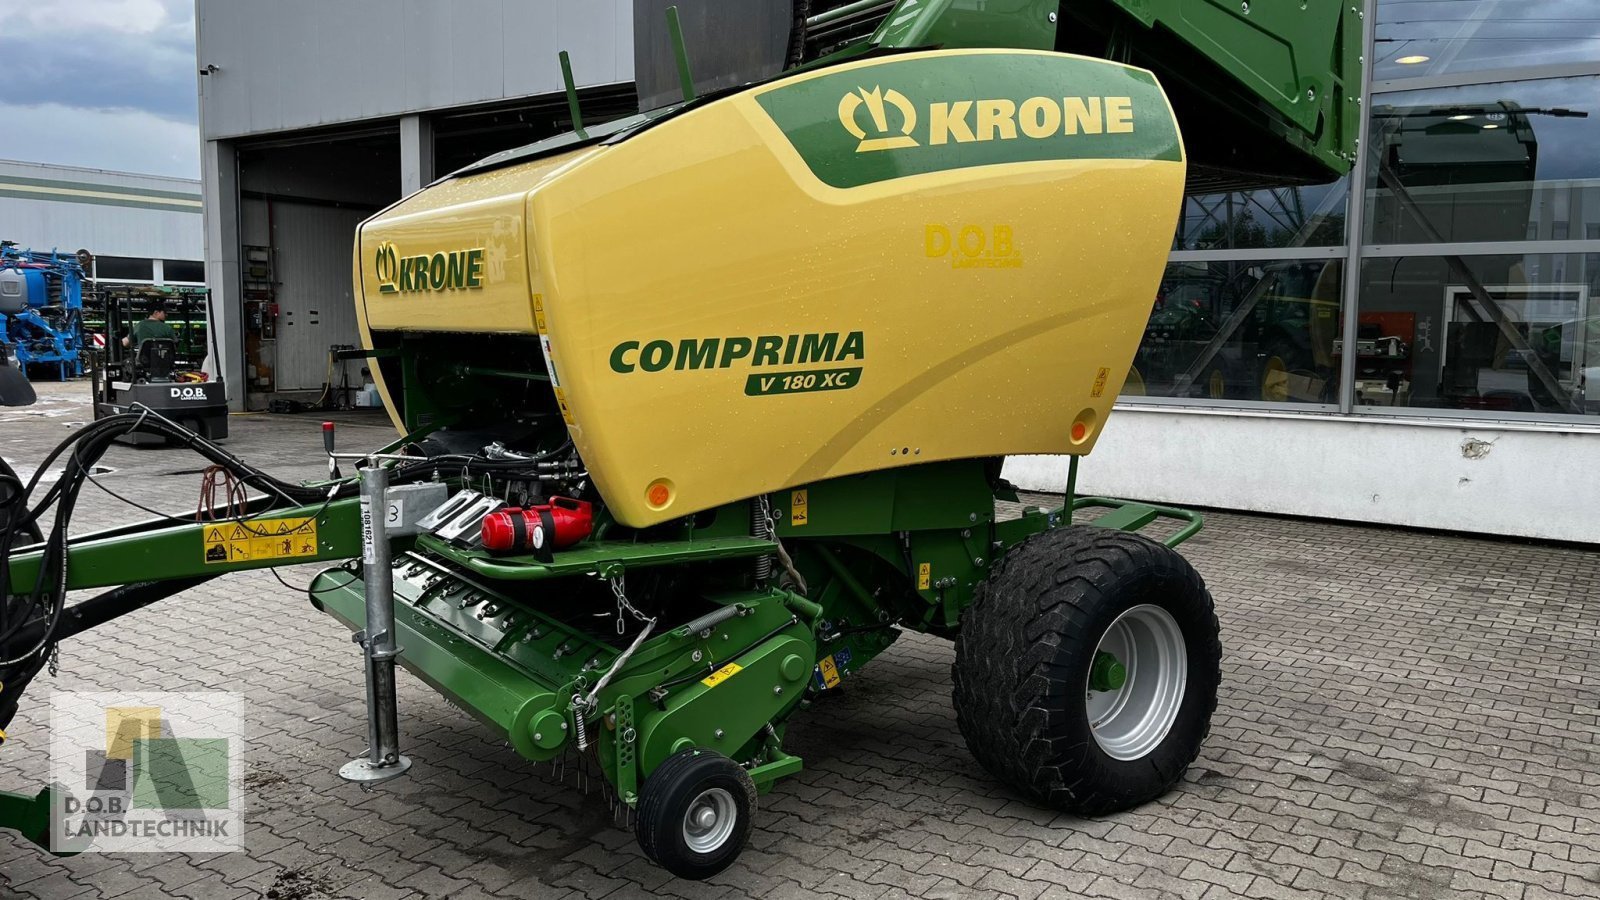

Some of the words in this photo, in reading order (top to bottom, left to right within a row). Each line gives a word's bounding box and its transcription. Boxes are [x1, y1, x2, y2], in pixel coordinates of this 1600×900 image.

[929, 96, 1134, 146] KRONE
[925, 224, 1020, 257] D.O.B.
[400, 248, 484, 292] KRONE
[609, 331, 865, 374] COMPRIMA
[171, 387, 206, 398] D.O.B.
[760, 377, 777, 392] V
[782, 374, 815, 390] 180
[820, 371, 850, 388] XC
[364, 510, 373, 545] 1081621
[388, 504, 399, 522] 3
